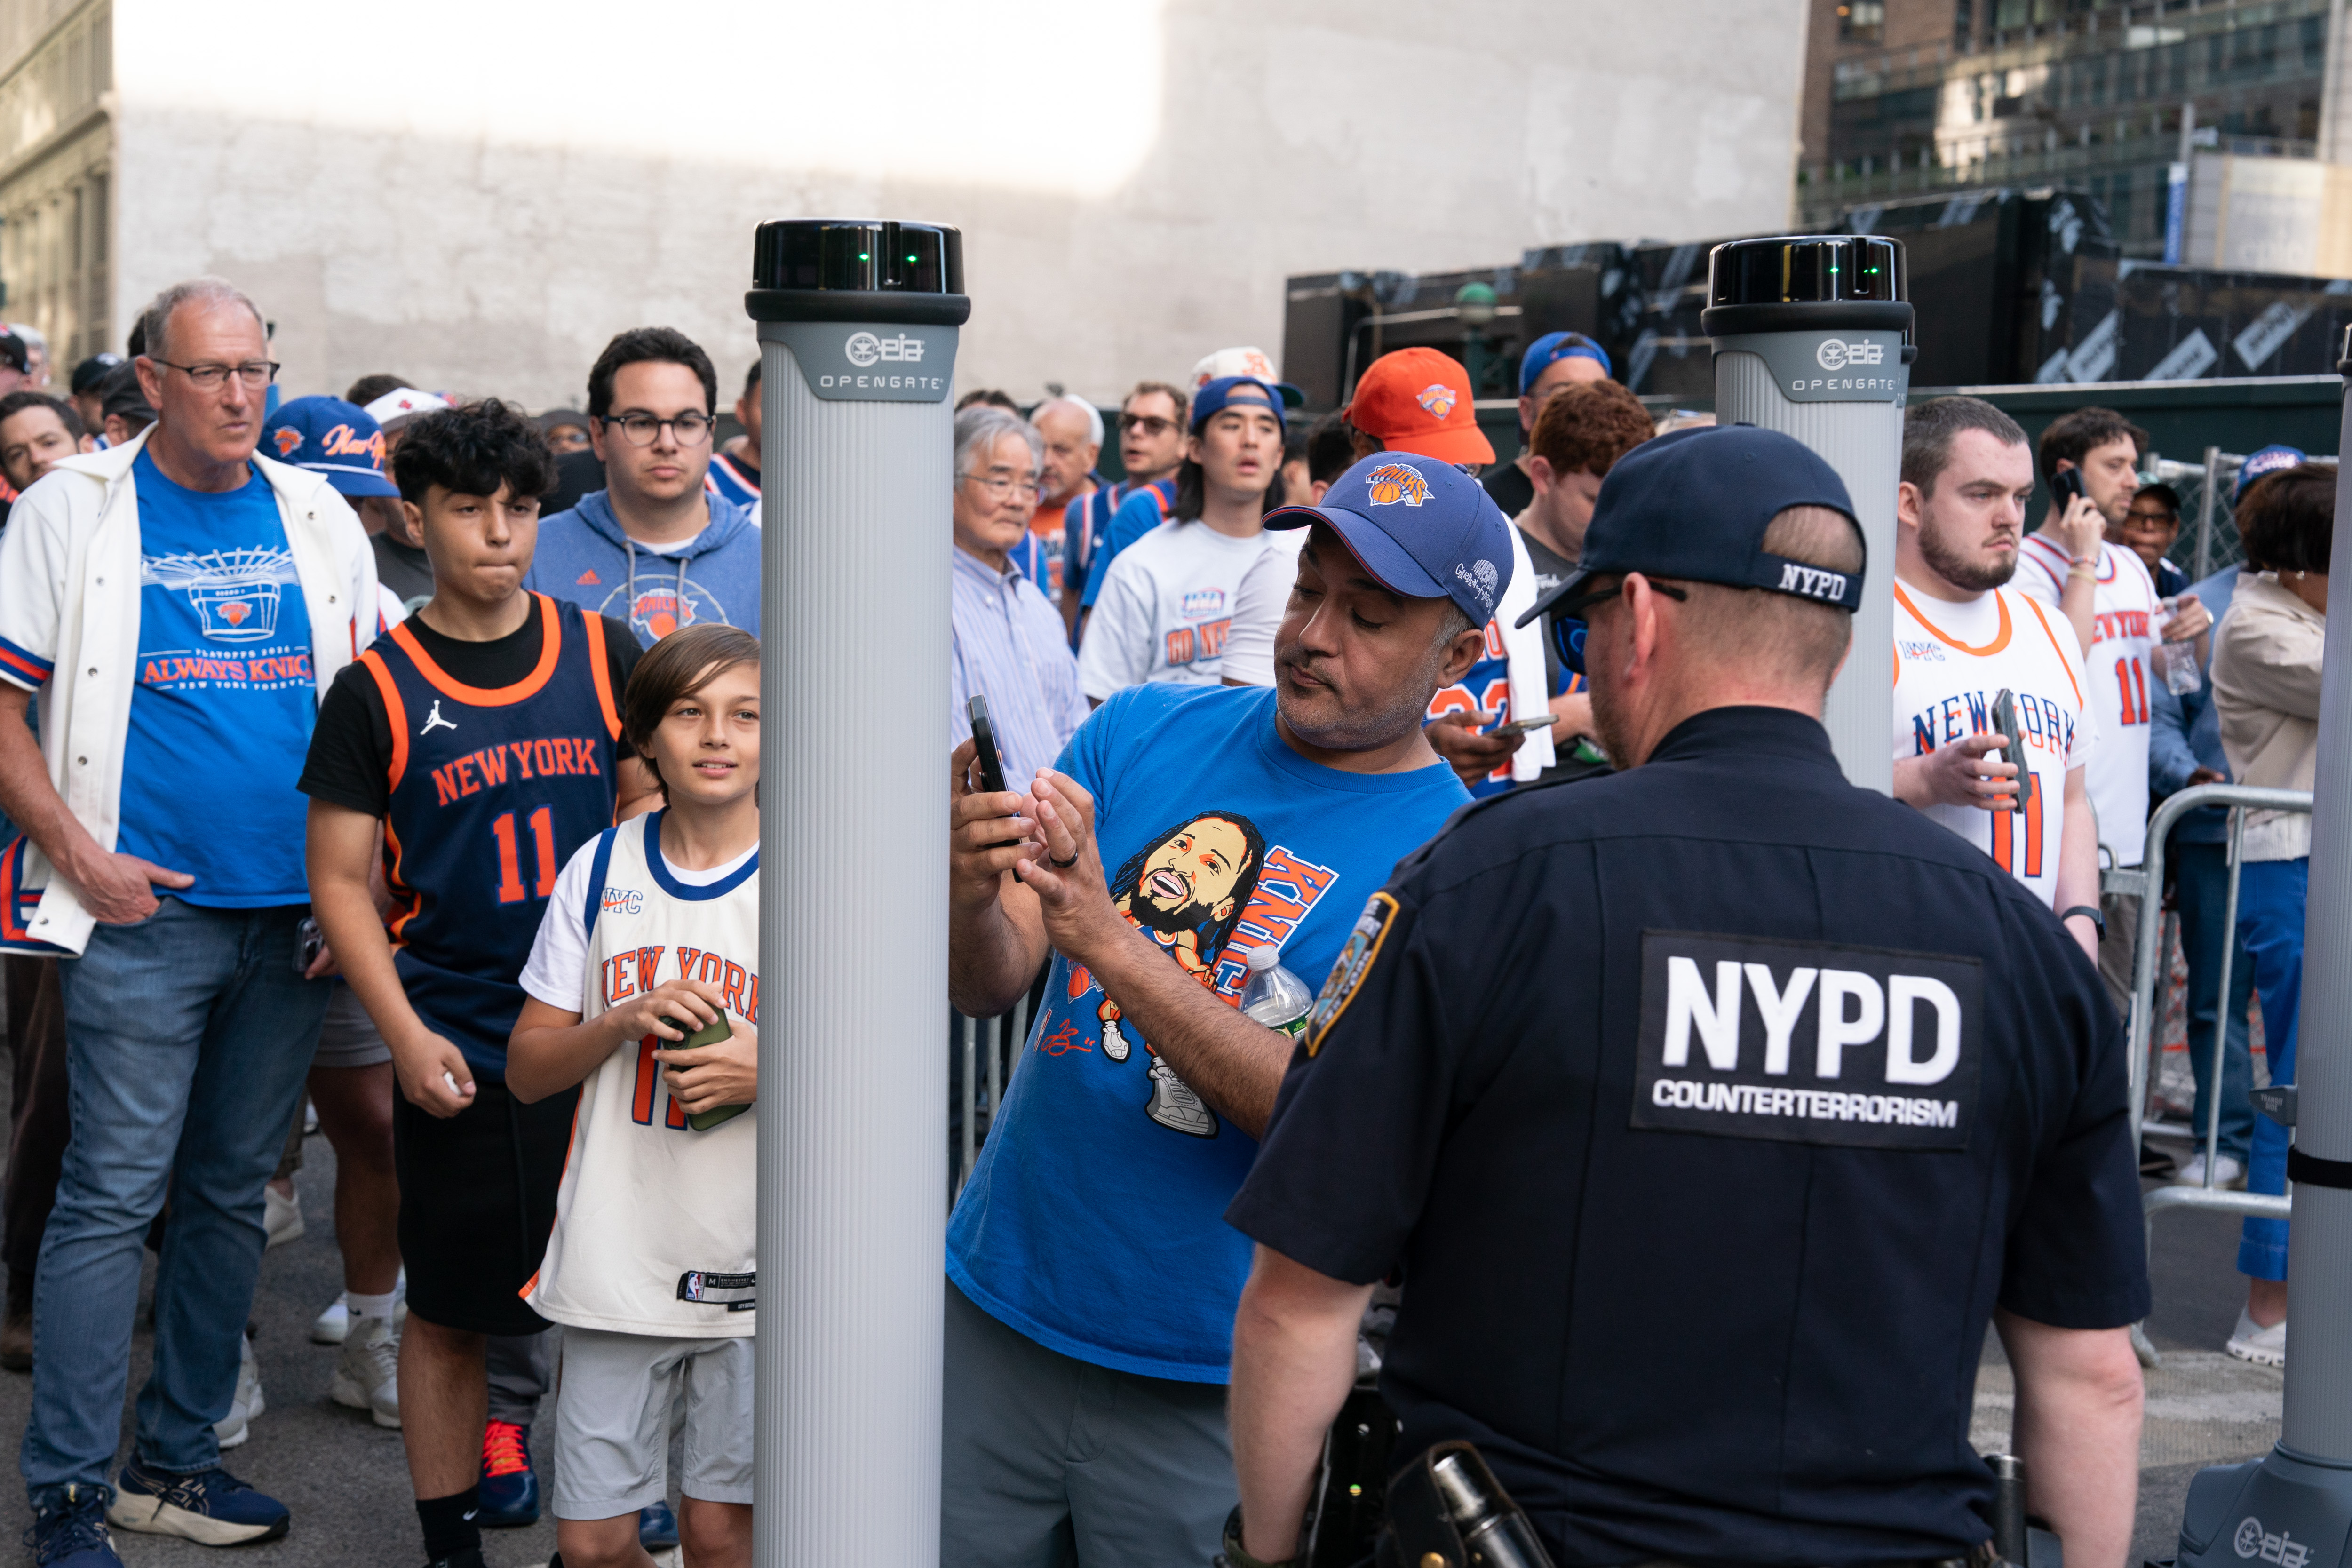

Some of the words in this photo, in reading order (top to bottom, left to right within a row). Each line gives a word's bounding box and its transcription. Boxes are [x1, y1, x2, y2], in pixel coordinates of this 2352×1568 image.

[820, 375, 941, 390] OPENGATE
[1792, 378, 1894, 390] OPENGATE
[1368, 466, 1426, 504] KNICKS
[1410, 469, 1421, 479] YORK
[1778, 564, 1847, 601] NYPD
[195, 647, 256, 659] PLAYOFFS
[1166, 627, 1195, 667] GO
[1899, 641, 1945, 661] NYC
[143, 657, 246, 683] ALWAYS
[179, 681, 208, 690] NEW
[215, 681, 247, 690] YORK
[2115, 656, 2149, 726] 11
[1912, 691, 1987, 756] NEW
[1997, 692, 2075, 769] ORK
[431, 745, 507, 807] NEW
[510, 738, 600, 780] YORK
[1990, 772, 2043, 878] 11
[490, 803, 557, 907] 11
[601, 888, 643, 914] NYC
[1213, 845, 1340, 1011] KNIC
[1662, 956, 1962, 1086] NYPD
[1652, 1079, 1958, 1128] COUNTERTERRORISM
[2261, 1093, 2284, 1107] TRANSIT
